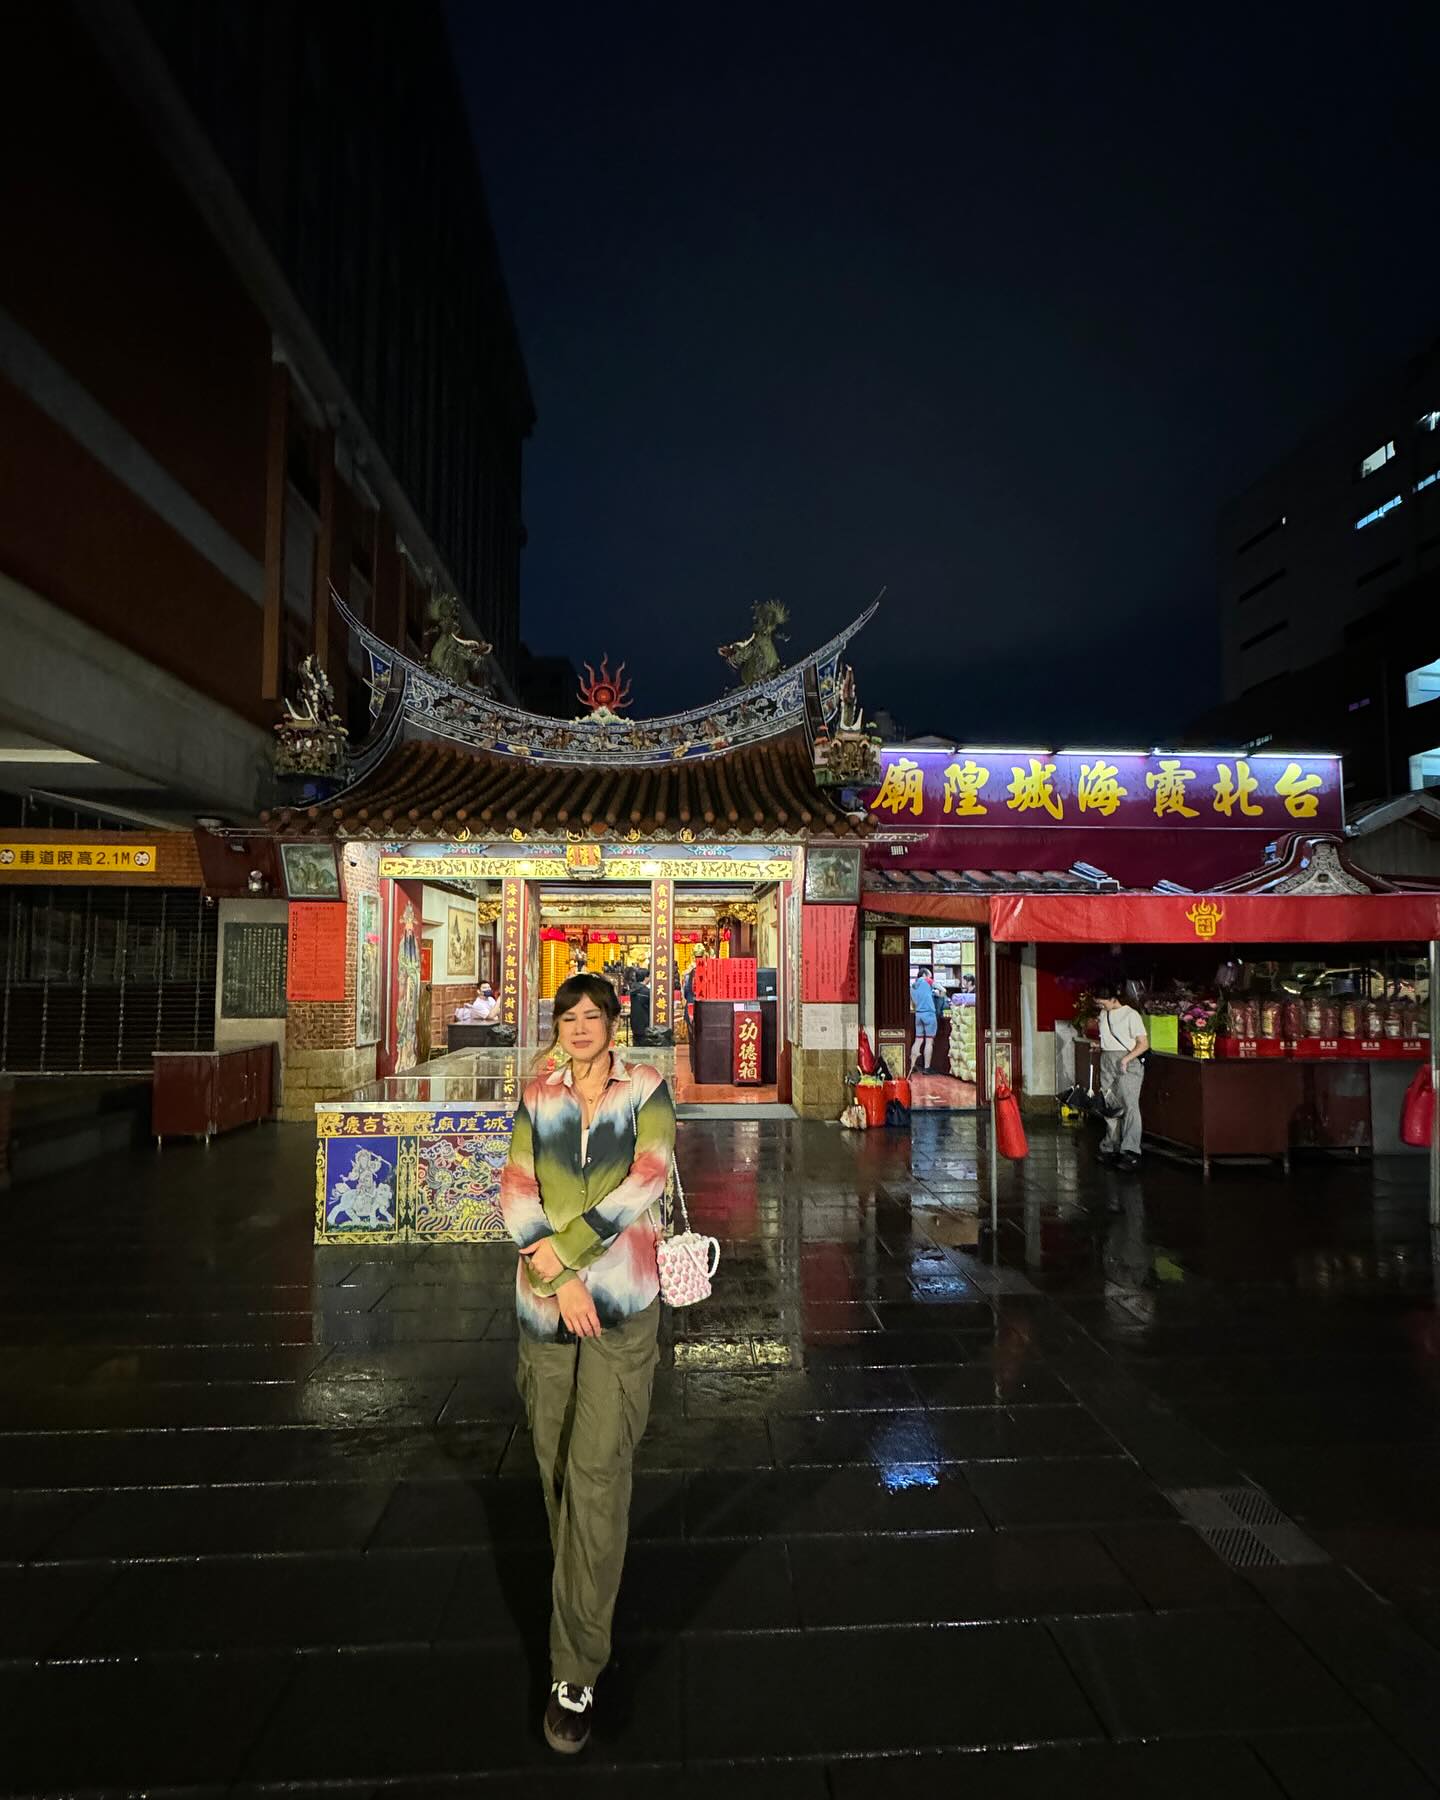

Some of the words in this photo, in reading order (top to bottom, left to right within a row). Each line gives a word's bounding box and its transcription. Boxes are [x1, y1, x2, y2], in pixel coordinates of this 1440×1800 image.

[871, 760, 1323, 820] 台北霞海城隍廟
[20, 850, 130, 866] 車道限高2.1M
[738, 1022, 758, 1080] 功德箱
